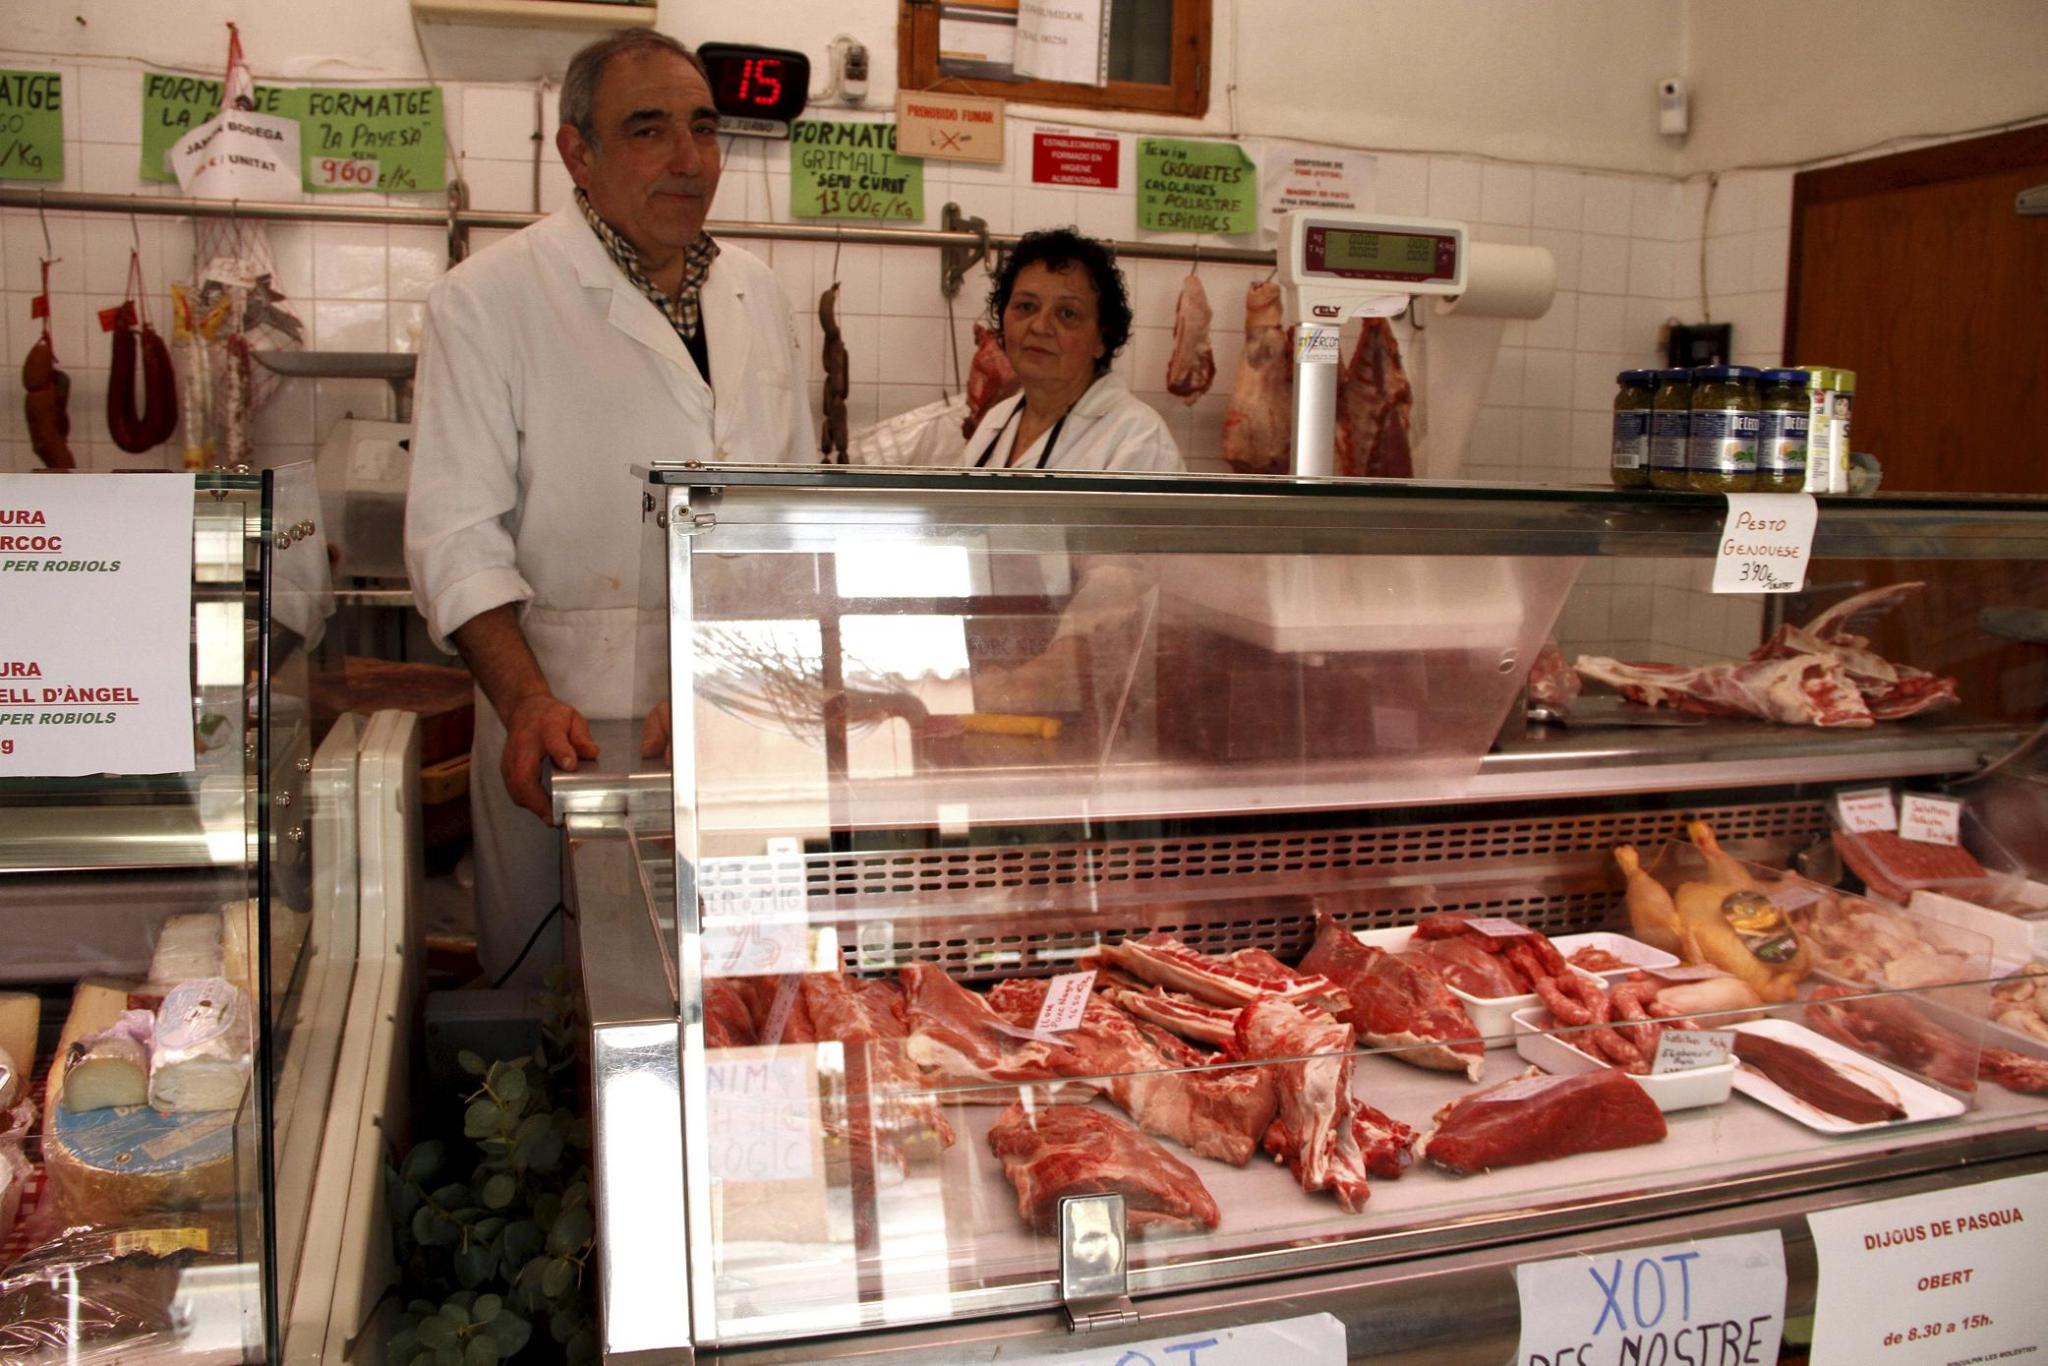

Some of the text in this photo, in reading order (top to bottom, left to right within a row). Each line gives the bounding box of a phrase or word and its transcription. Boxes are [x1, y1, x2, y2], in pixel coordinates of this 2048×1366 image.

[739, 59, 782, 105] 15
[309, 91, 433, 117] FORMATGE
[907, 104, 994, 123] PROHIBIDO FUMAR
[162, 107, 191, 127] LA
[227, 121, 284, 142] BODEGA
[791, 121, 896, 149] FORMATG
[1042, 137, 1111, 152] ESTABLECIMIENTO
[228, 154, 277, 172] UNITAT
[803, 149, 892, 176] GRIMALT
[1161, 160, 1242, 184] CROQUETES
[1164, 193, 1241, 213] POLLASTRE
[1736, 511, 1787, 532] PESTO
[3, 560, 122, 572] PER ROBIOLS
[43, 684, 139, 703] D'ÀNGEL
[0, 712, 117, 725] PER ROBIOLS
[1864, 1207, 2025, 1251] DIJOUS DE PASQUA
[1917, 1268, 1974, 1292] OBERT
[1588, 1251, 1701, 1336] XOT
[1883, 1314, 1994, 1347] de 8.30 a 15h.
